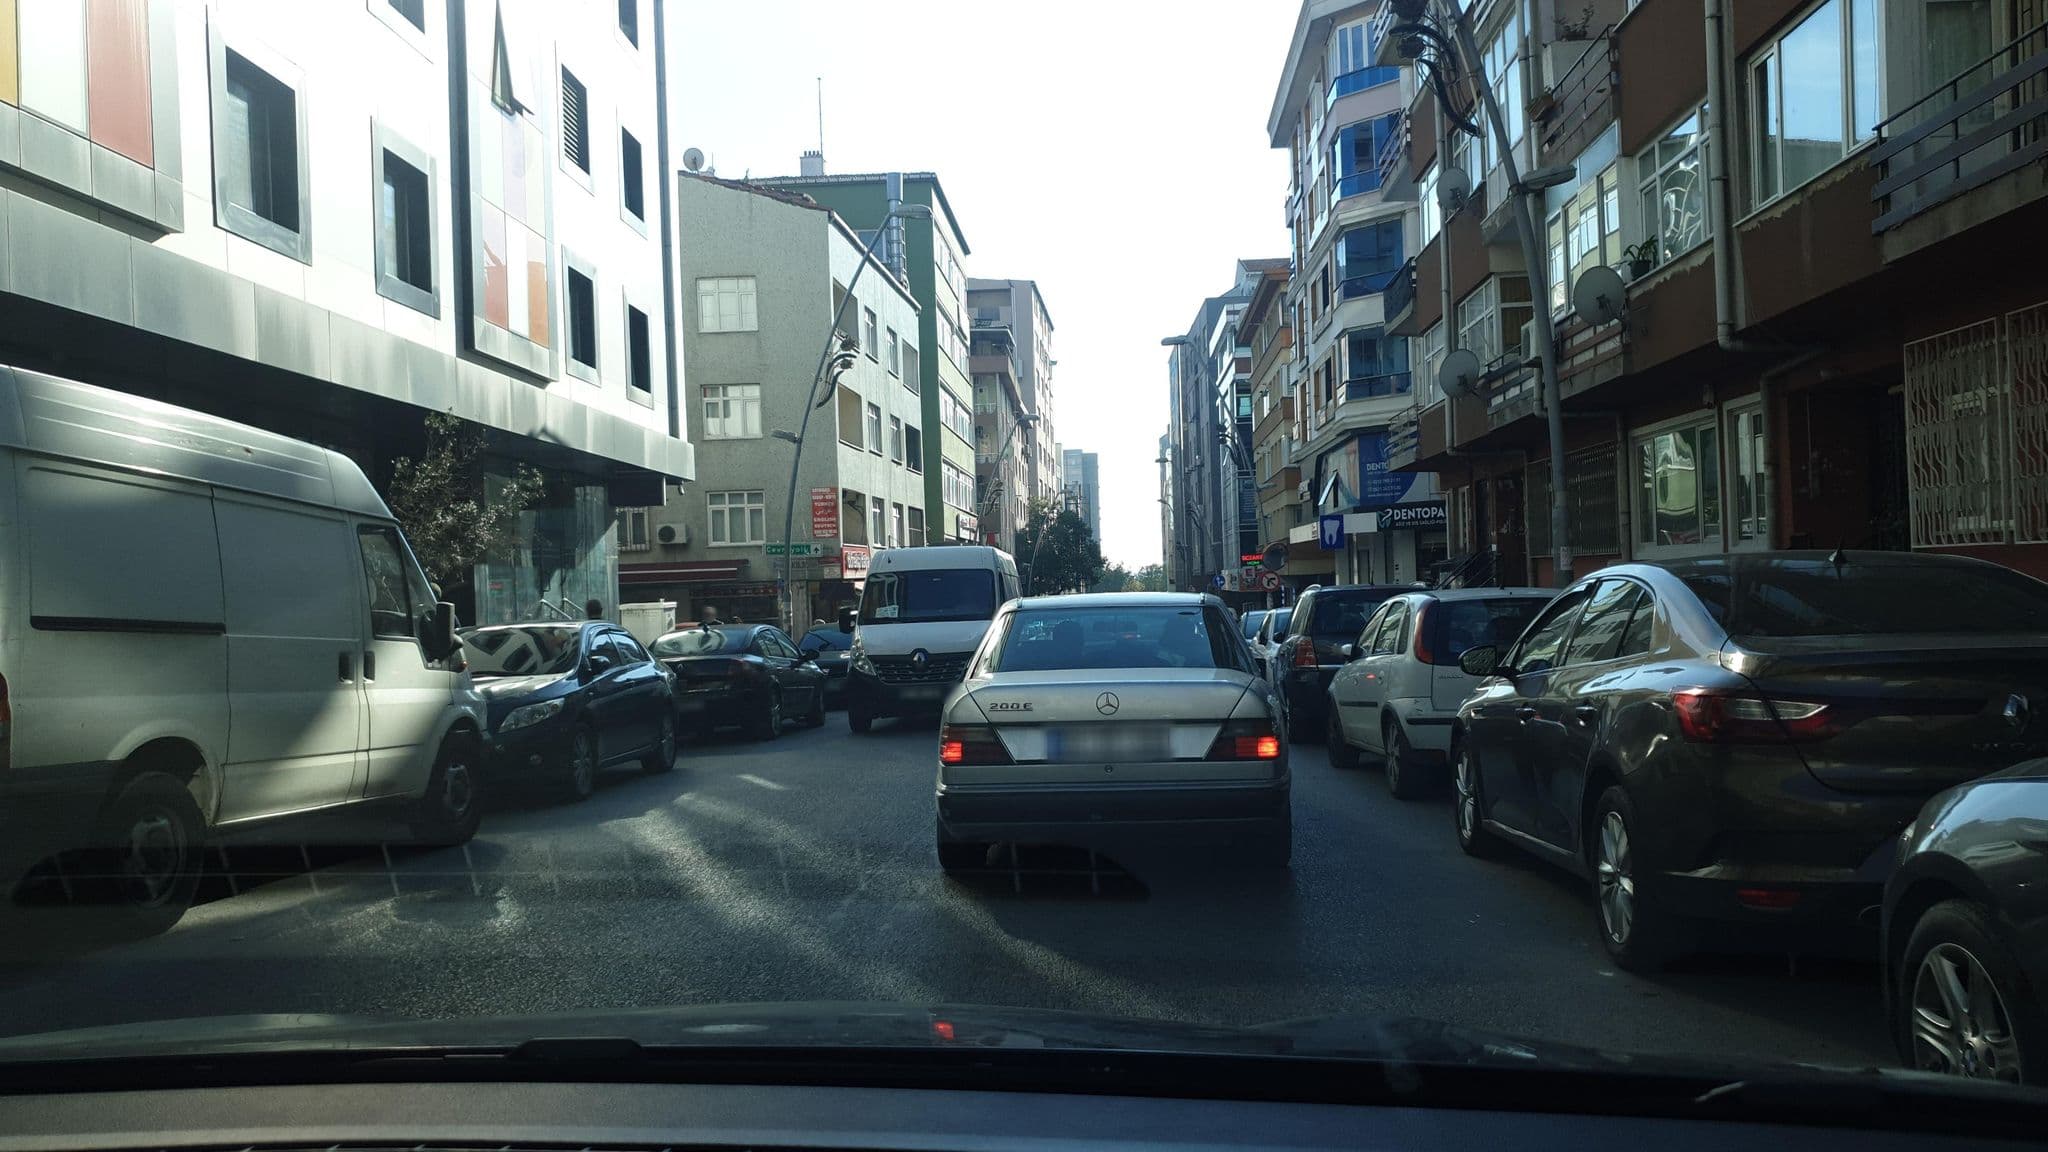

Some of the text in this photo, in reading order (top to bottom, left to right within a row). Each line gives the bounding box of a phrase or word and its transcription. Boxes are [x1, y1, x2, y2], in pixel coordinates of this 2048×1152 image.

[1394, 506, 1445, 520] DENTOPA
[990, 702, 1033, 710] 200 E
